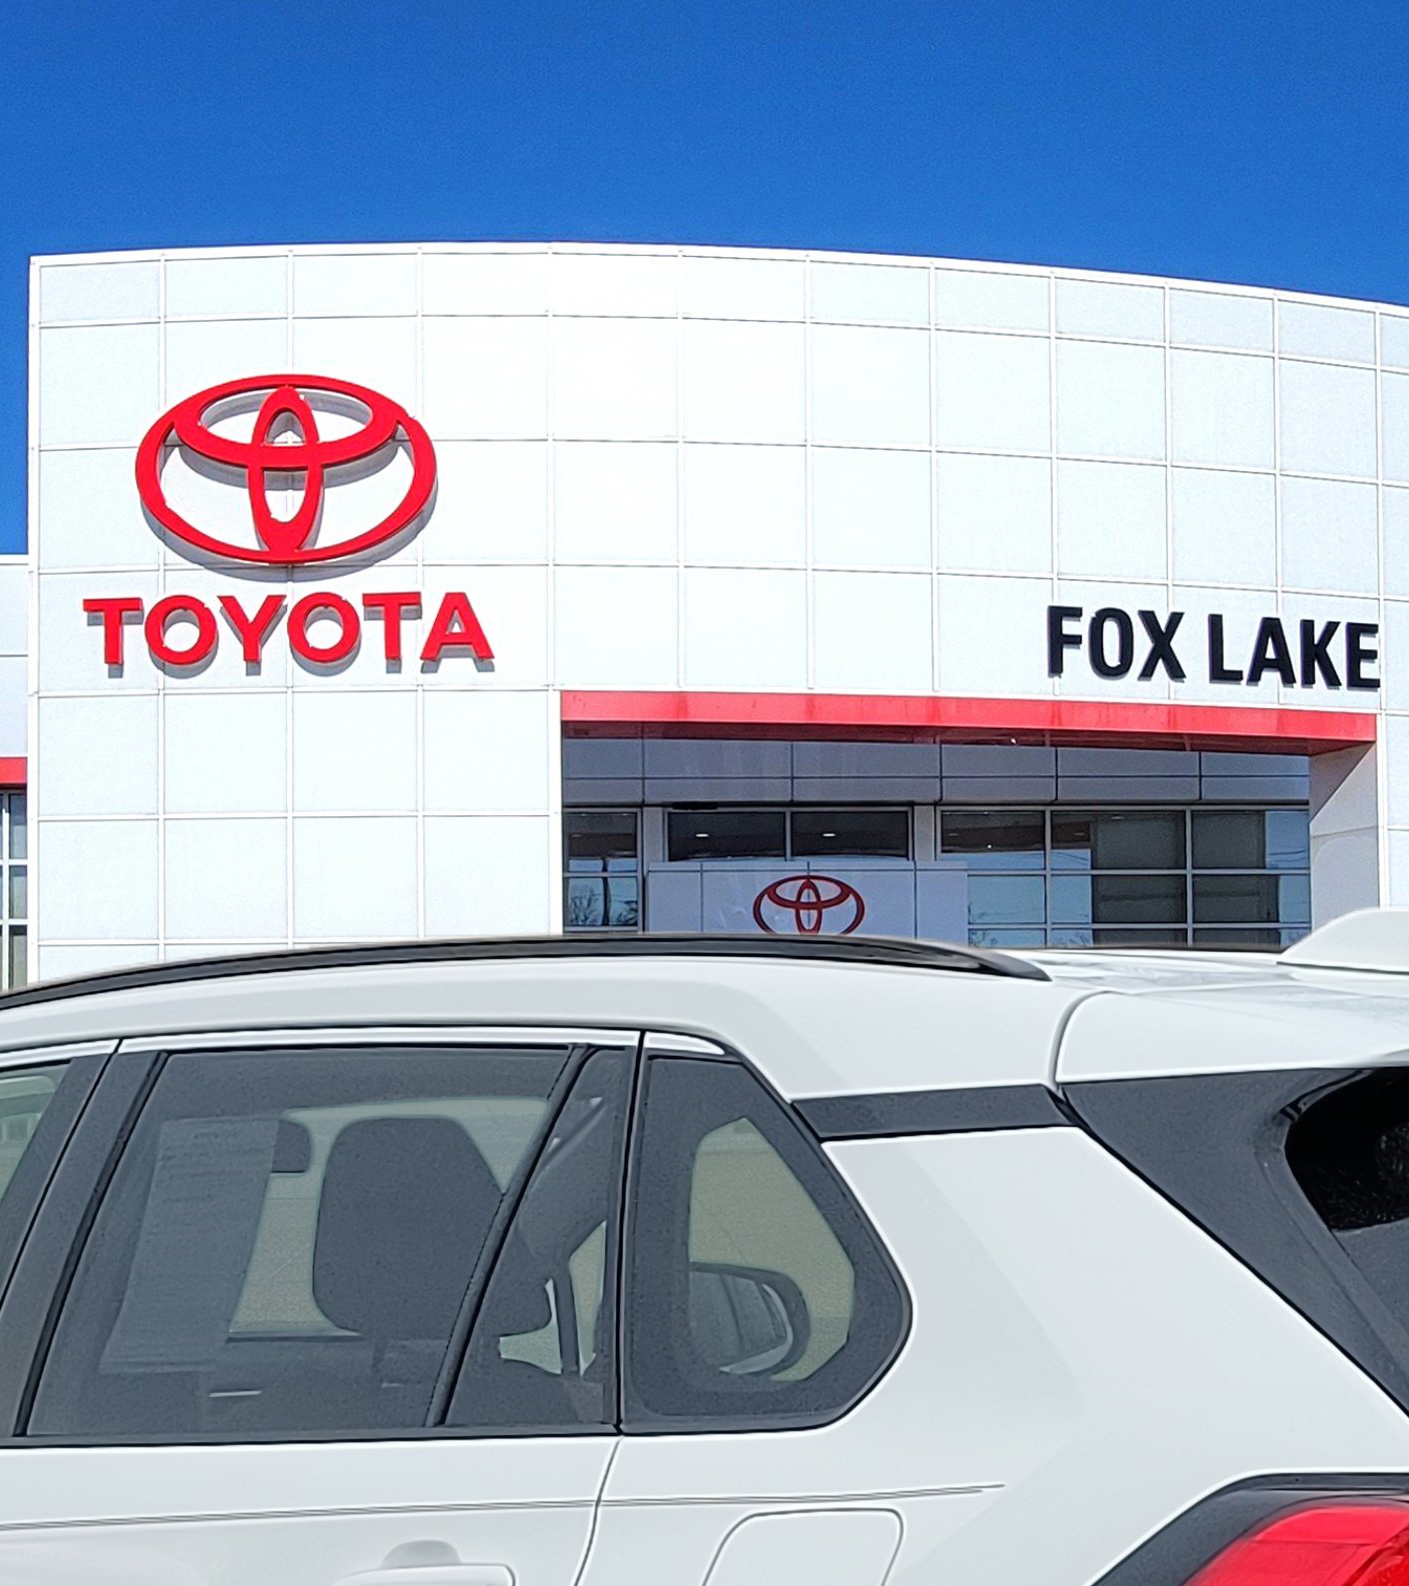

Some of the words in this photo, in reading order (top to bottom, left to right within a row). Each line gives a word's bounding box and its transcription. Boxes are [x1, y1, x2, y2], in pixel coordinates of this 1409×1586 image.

[82, 591, 494, 672] TOYOTA
[1047, 605, 1186, 683] FOX
[1208, 613, 1381, 690] LAKE
